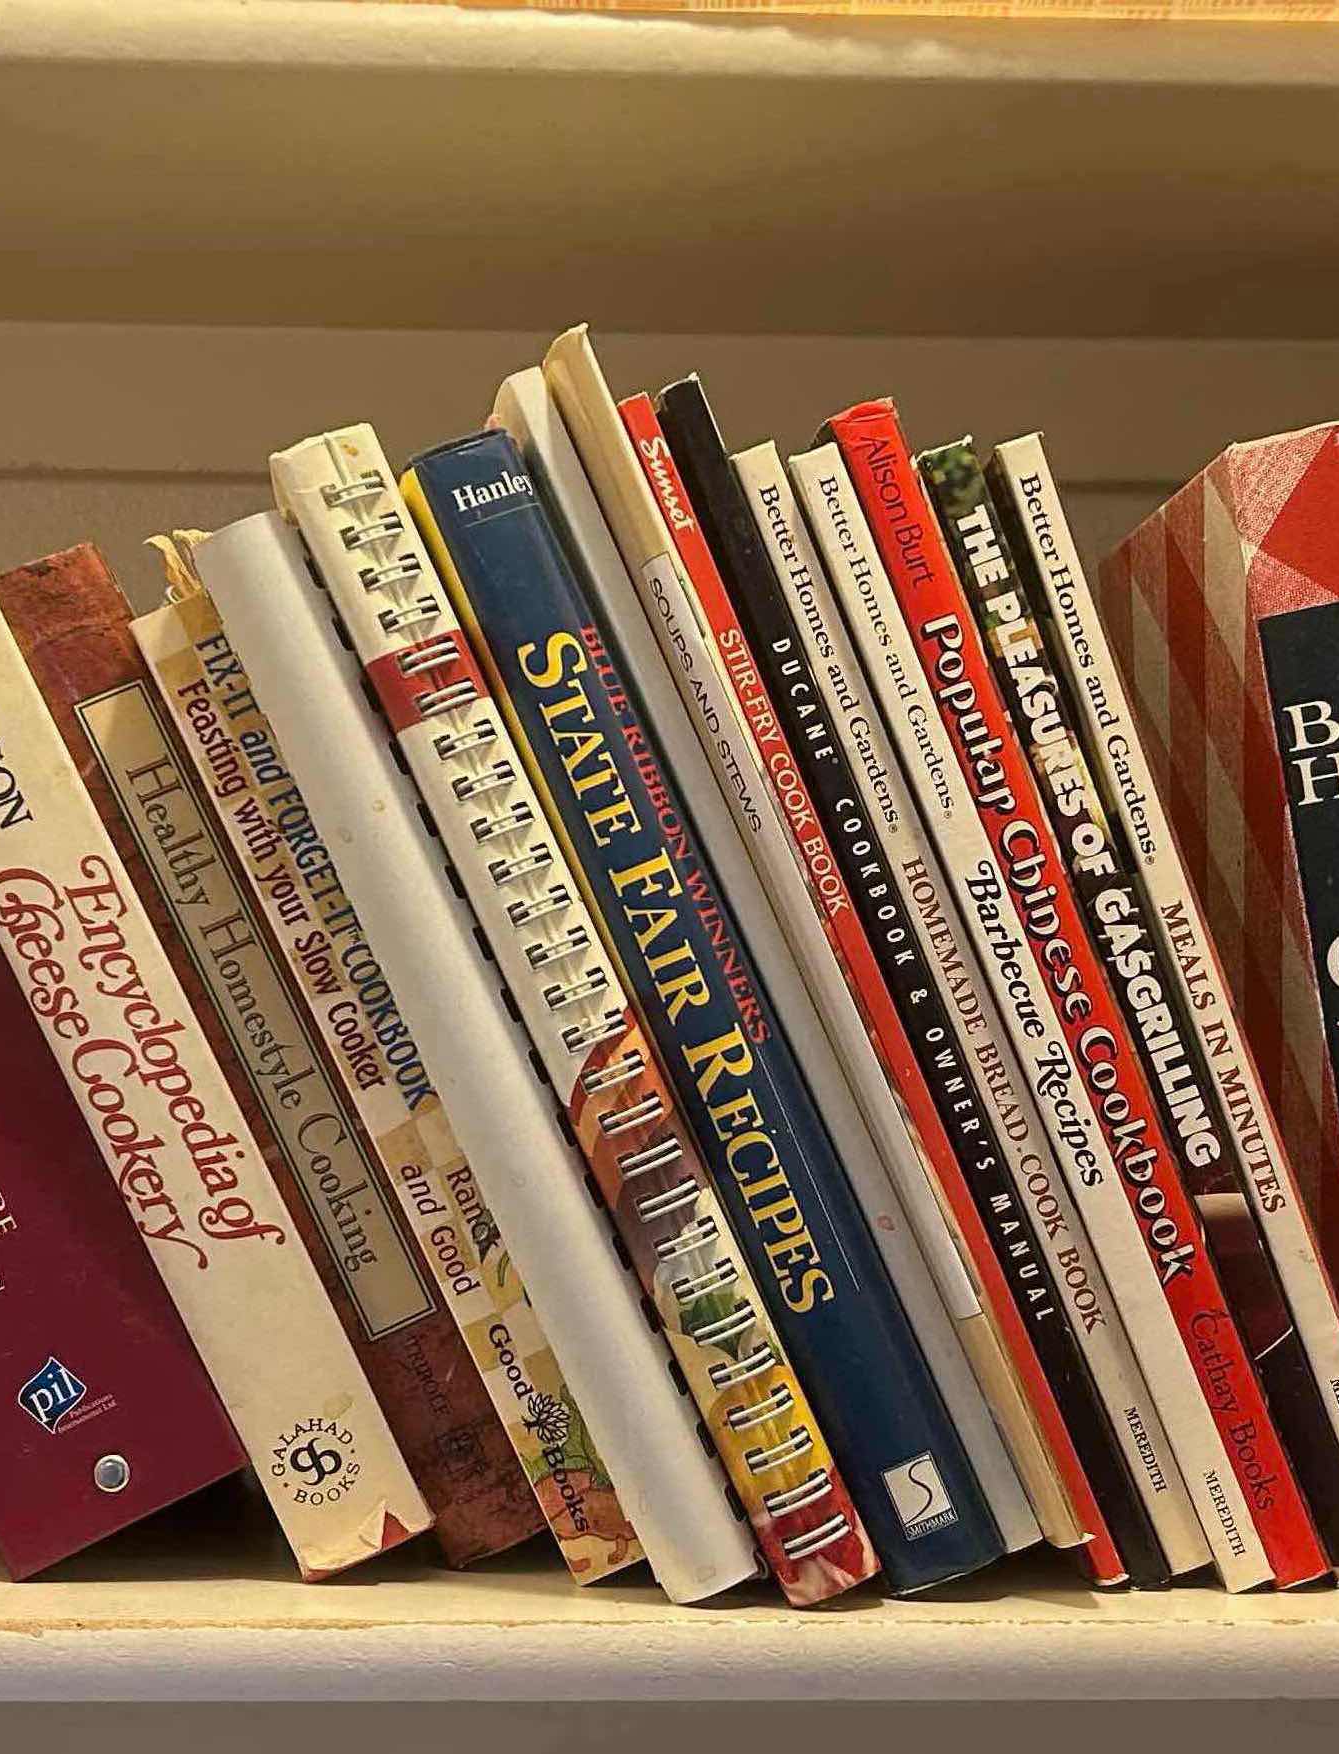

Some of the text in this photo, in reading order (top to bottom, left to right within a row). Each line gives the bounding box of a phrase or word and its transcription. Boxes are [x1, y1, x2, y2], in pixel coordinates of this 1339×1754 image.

[761, 483, 859, 712] Better Homes and
[820, 474, 917, 699] Better Homes and
[861, 436, 935, 588] Alison Burt
[1019, 472, 1119, 729] Better Homes and
[177, 678, 249, 799] Feasting
[240, 730, 293, 795] and
[651, 577, 762, 834] SOUPS AND STEWS
[720, 628, 850, 917] STIR-FRY COOK BOOK
[957, 505, 1009, 589] THE
[985, 590, 1088, 818] PLEASURES
[1071, 822, 1116, 878] OF
[233, 797, 286, 864] with
[257, 862, 309, 927] your
[63, 854, 244, 1197] Encyclopedia
[125, 756, 378, 1274] Healthy Homestyle Cooking
[328, 1001, 386, 1091] Cooker
[518, 632, 836, 1313] STATE FAIR RECIPES
[683, 868, 772, 1046] WINNERS
[922, 613, 1197, 1287] Popular Cookbook
[965, 860, 1105, 1188] Barbecue Recipes
[1161, 898, 1287, 1214] MEALS IN MINUTES
[72, 1038, 208, 1271] Cookery
[902, 856, 1106, 1335] HOMEMADE COOK BOOK
[911, 988, 928, 1004] &
[925, 1027, 996, 1170] OWNER'S
[990, 1193, 1054, 1321] MANUAL
[400, 1162, 483, 1296] and Good
[29, 1367, 79, 1423] pil
[271, 1418, 353, 1477] GALAHAD
[294, 1462, 361, 1506] BOOKS
[488, 1322, 591, 1533] Good Books
[1123, 1406, 1168, 1494] MEREDITH
[1188, 1308, 1277, 1511] Cathay Books
[1203, 1469, 1247, 1559] MEREDITH
